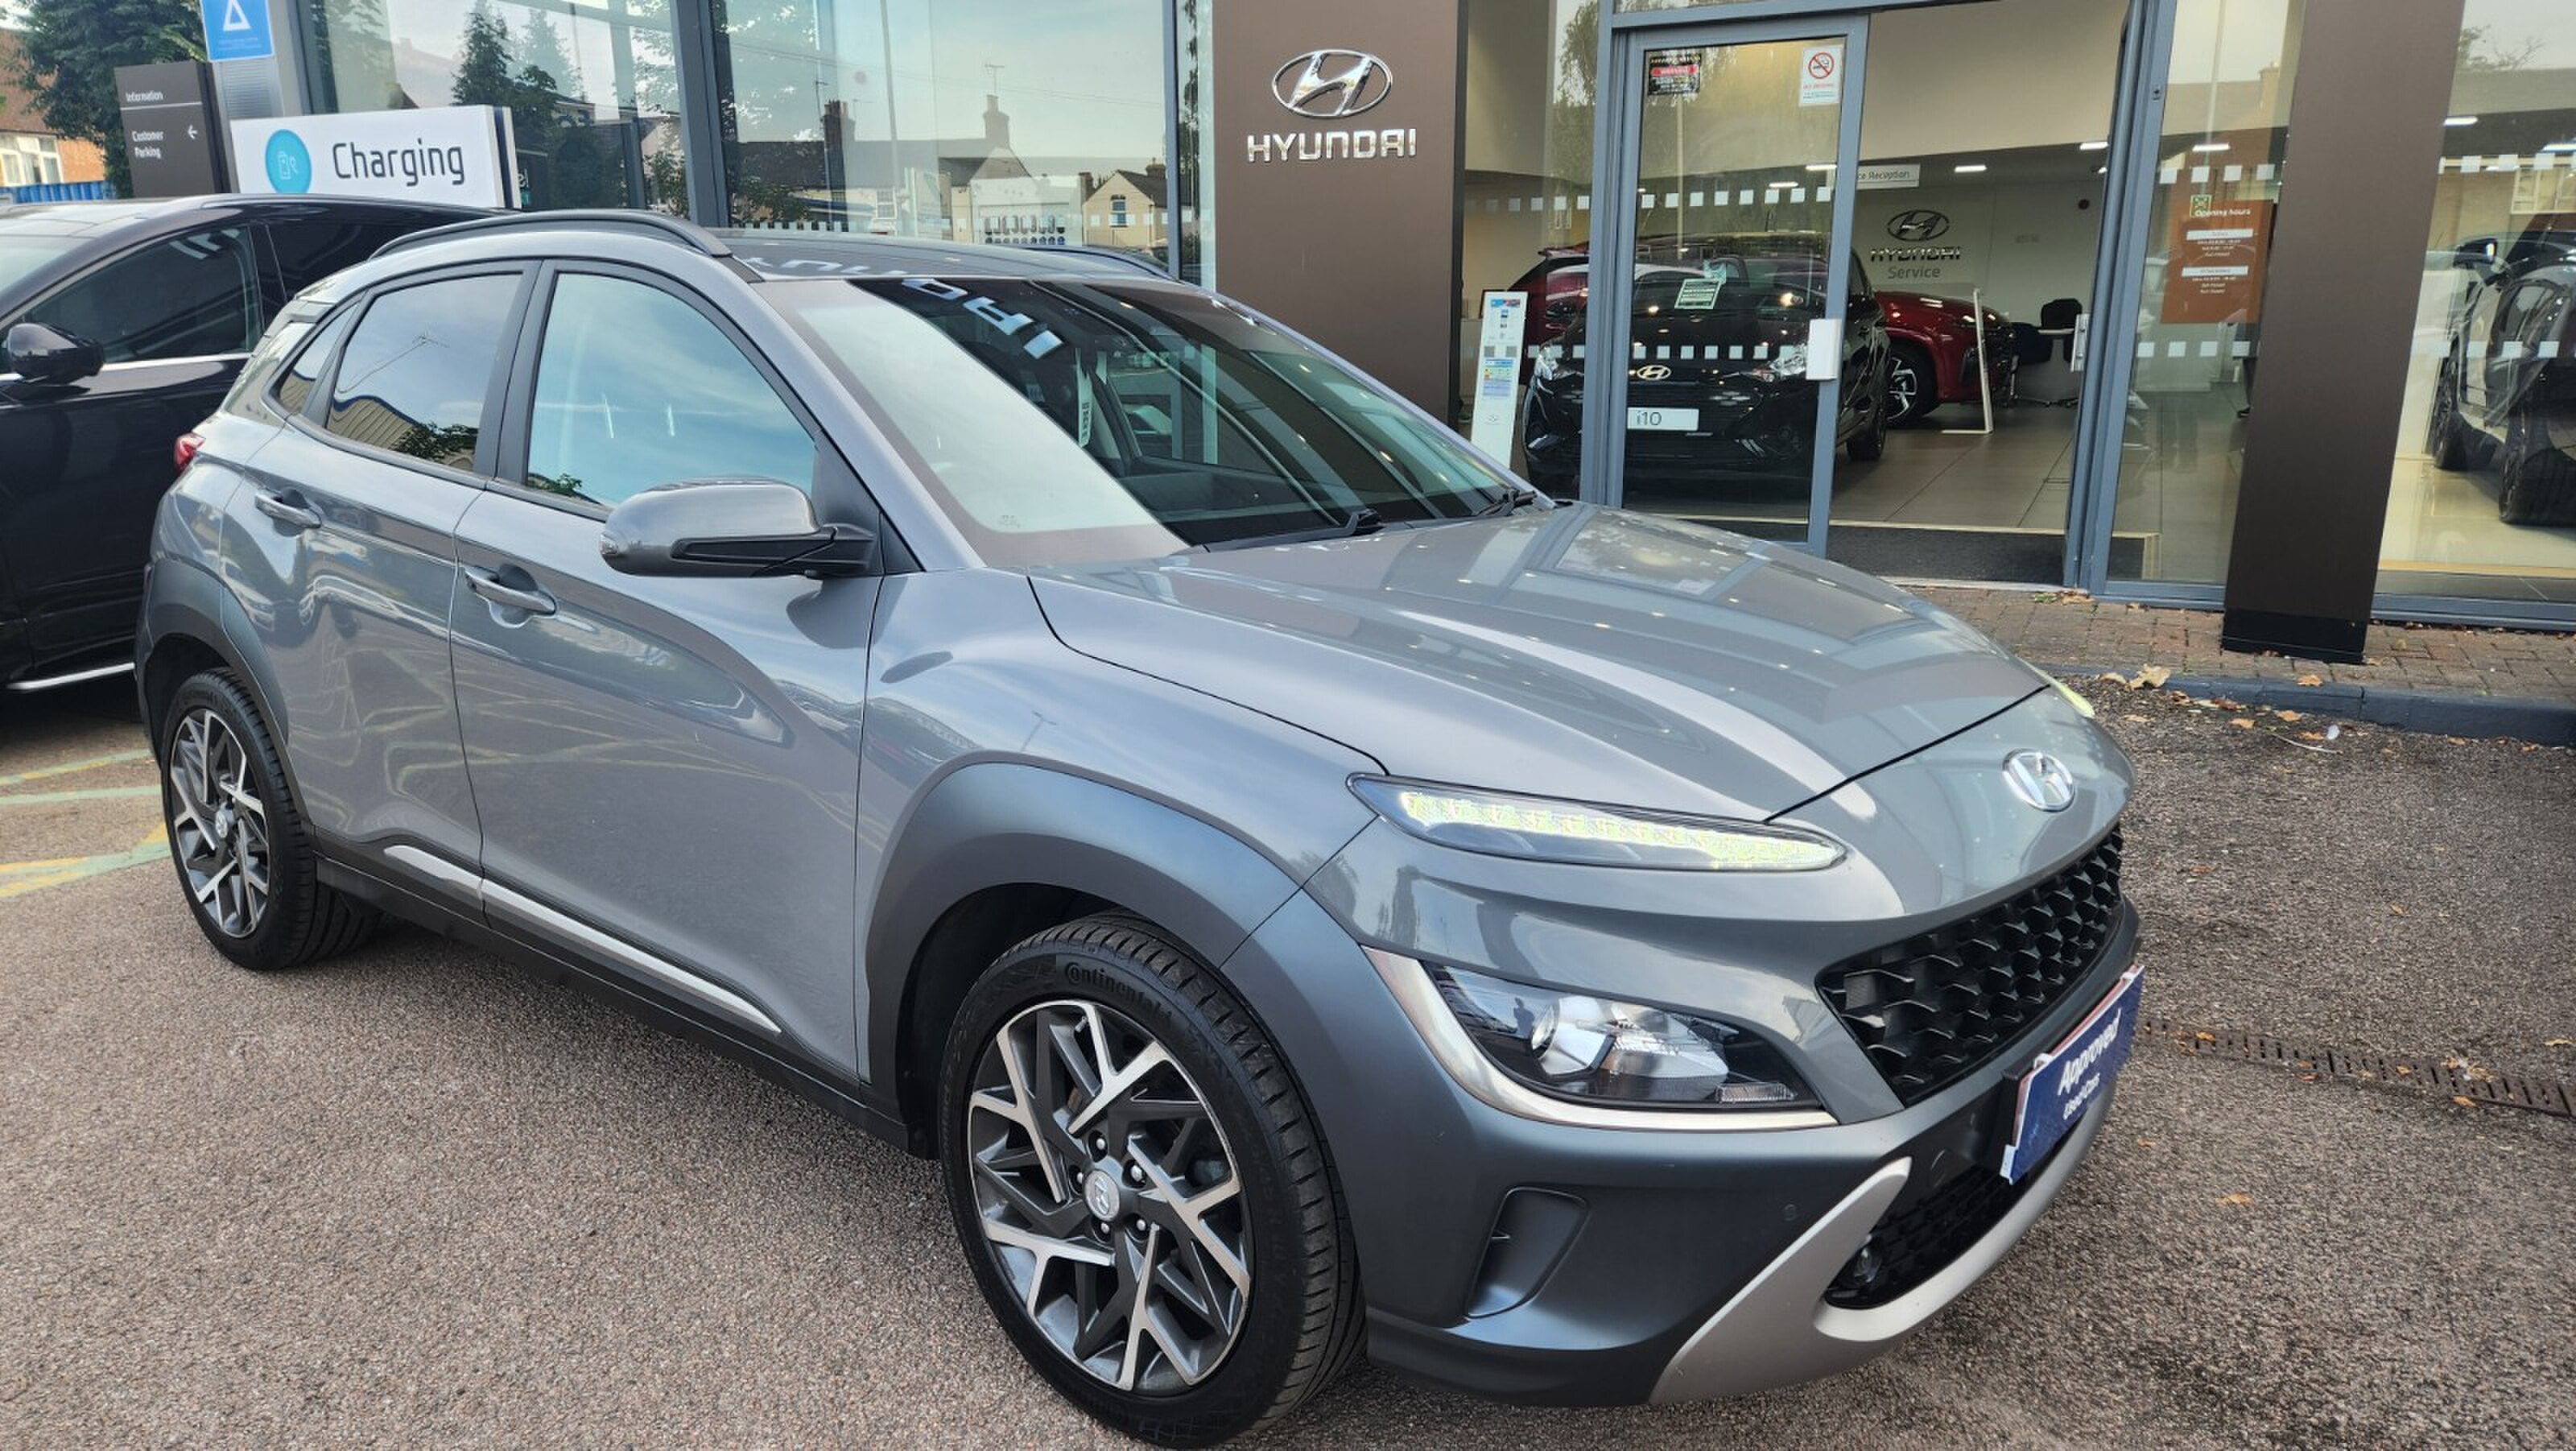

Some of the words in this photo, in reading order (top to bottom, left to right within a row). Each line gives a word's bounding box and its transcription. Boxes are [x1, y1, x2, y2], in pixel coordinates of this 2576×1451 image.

[1248, 128, 1417, 163] HYUNDAI
[332, 138, 465, 187] Charging
[1868, 170, 1910, 180] Reception
[2194, 209, 2227, 218] Opening
[2228, 208, 2251, 216] hours
[1870, 246, 1960, 263] HYUNDAI
[1888, 266, 1941, 279] Service
[1636, 410, 1662, 426] i10
[1064, 961, 1164, 1020] Continental
[2058, 1007, 2121, 1096] Approved
